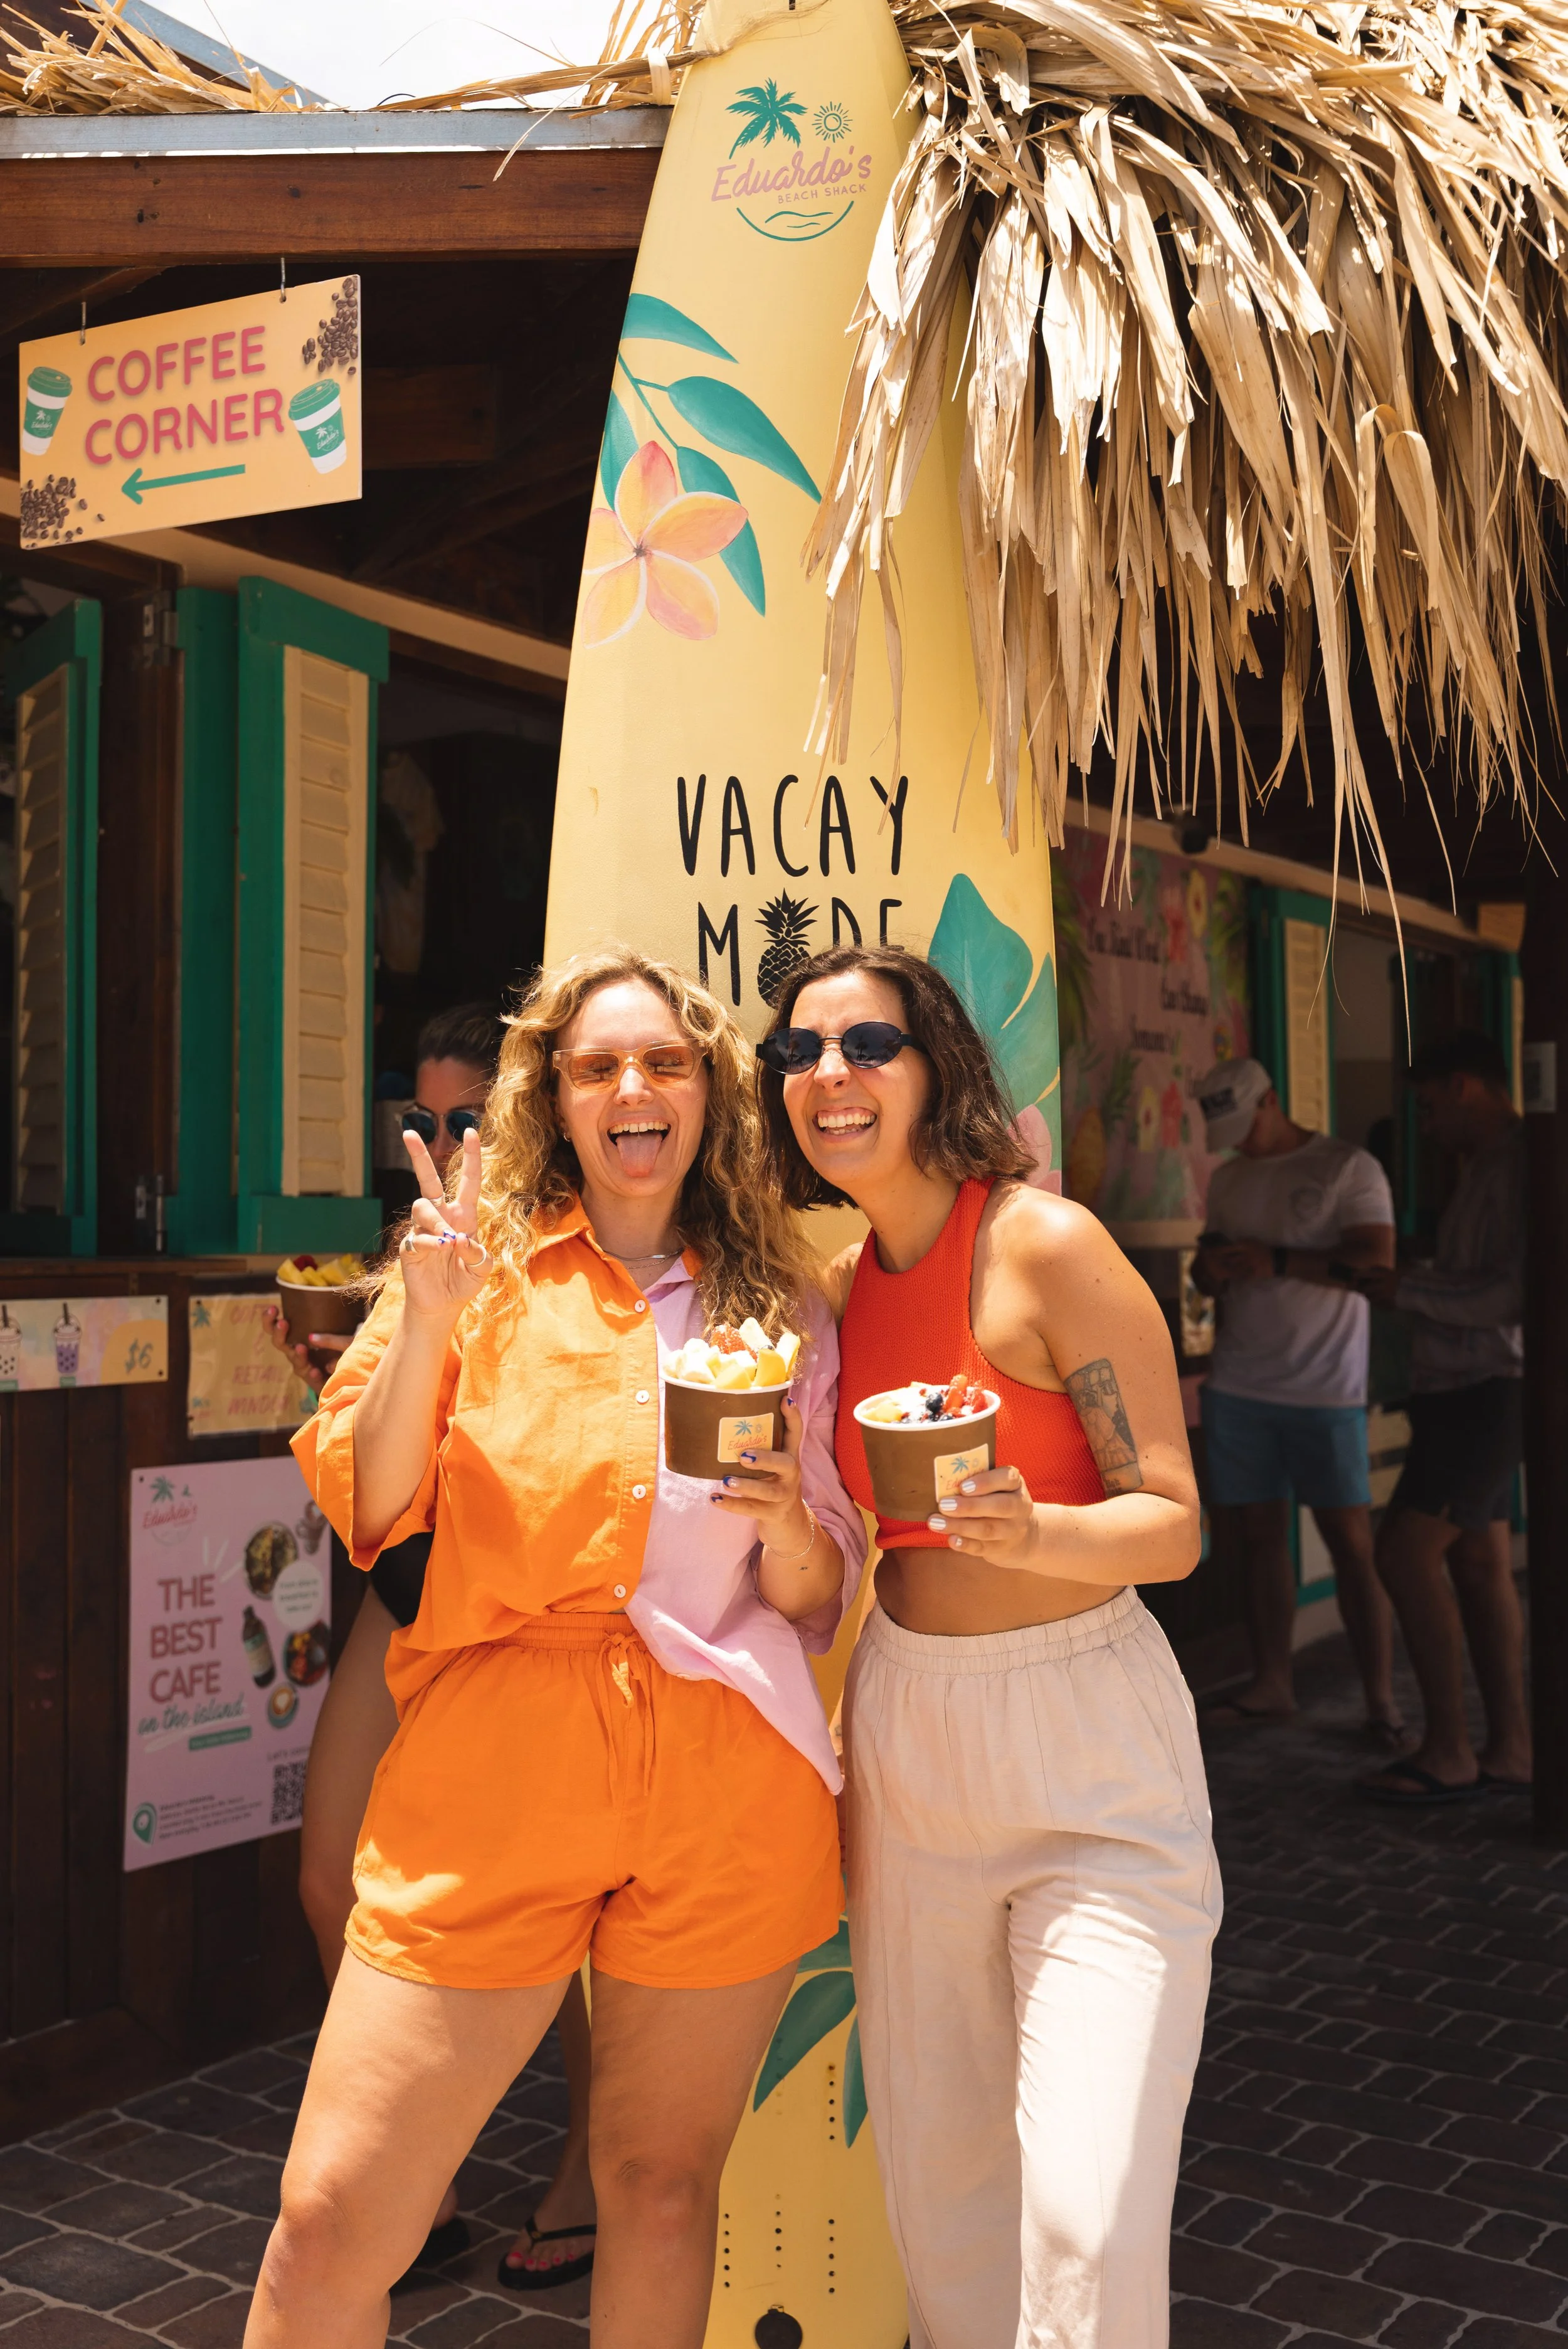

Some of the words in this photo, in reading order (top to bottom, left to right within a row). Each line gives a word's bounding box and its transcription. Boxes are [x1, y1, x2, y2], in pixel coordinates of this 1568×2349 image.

[711, 146, 872, 201] Eduardo's
[778, 189, 818, 204] BEACH
[825, 183, 867, 197] SHACK
[88, 326, 265, 401] COFFEE
[85, 388, 285, 465] CORNER
[677, 774, 908, 877] VACAY
[124, 1338, 154, 1376] $6
[158, 1574, 216, 1612] THE
[150, 1616, 223, 1660] BEST
[149, 1660, 221, 1704] CAFE
[138, 1717, 159, 1735] on
[163, 1704, 190, 1729] the
[194, 1692, 245, 1724] island
